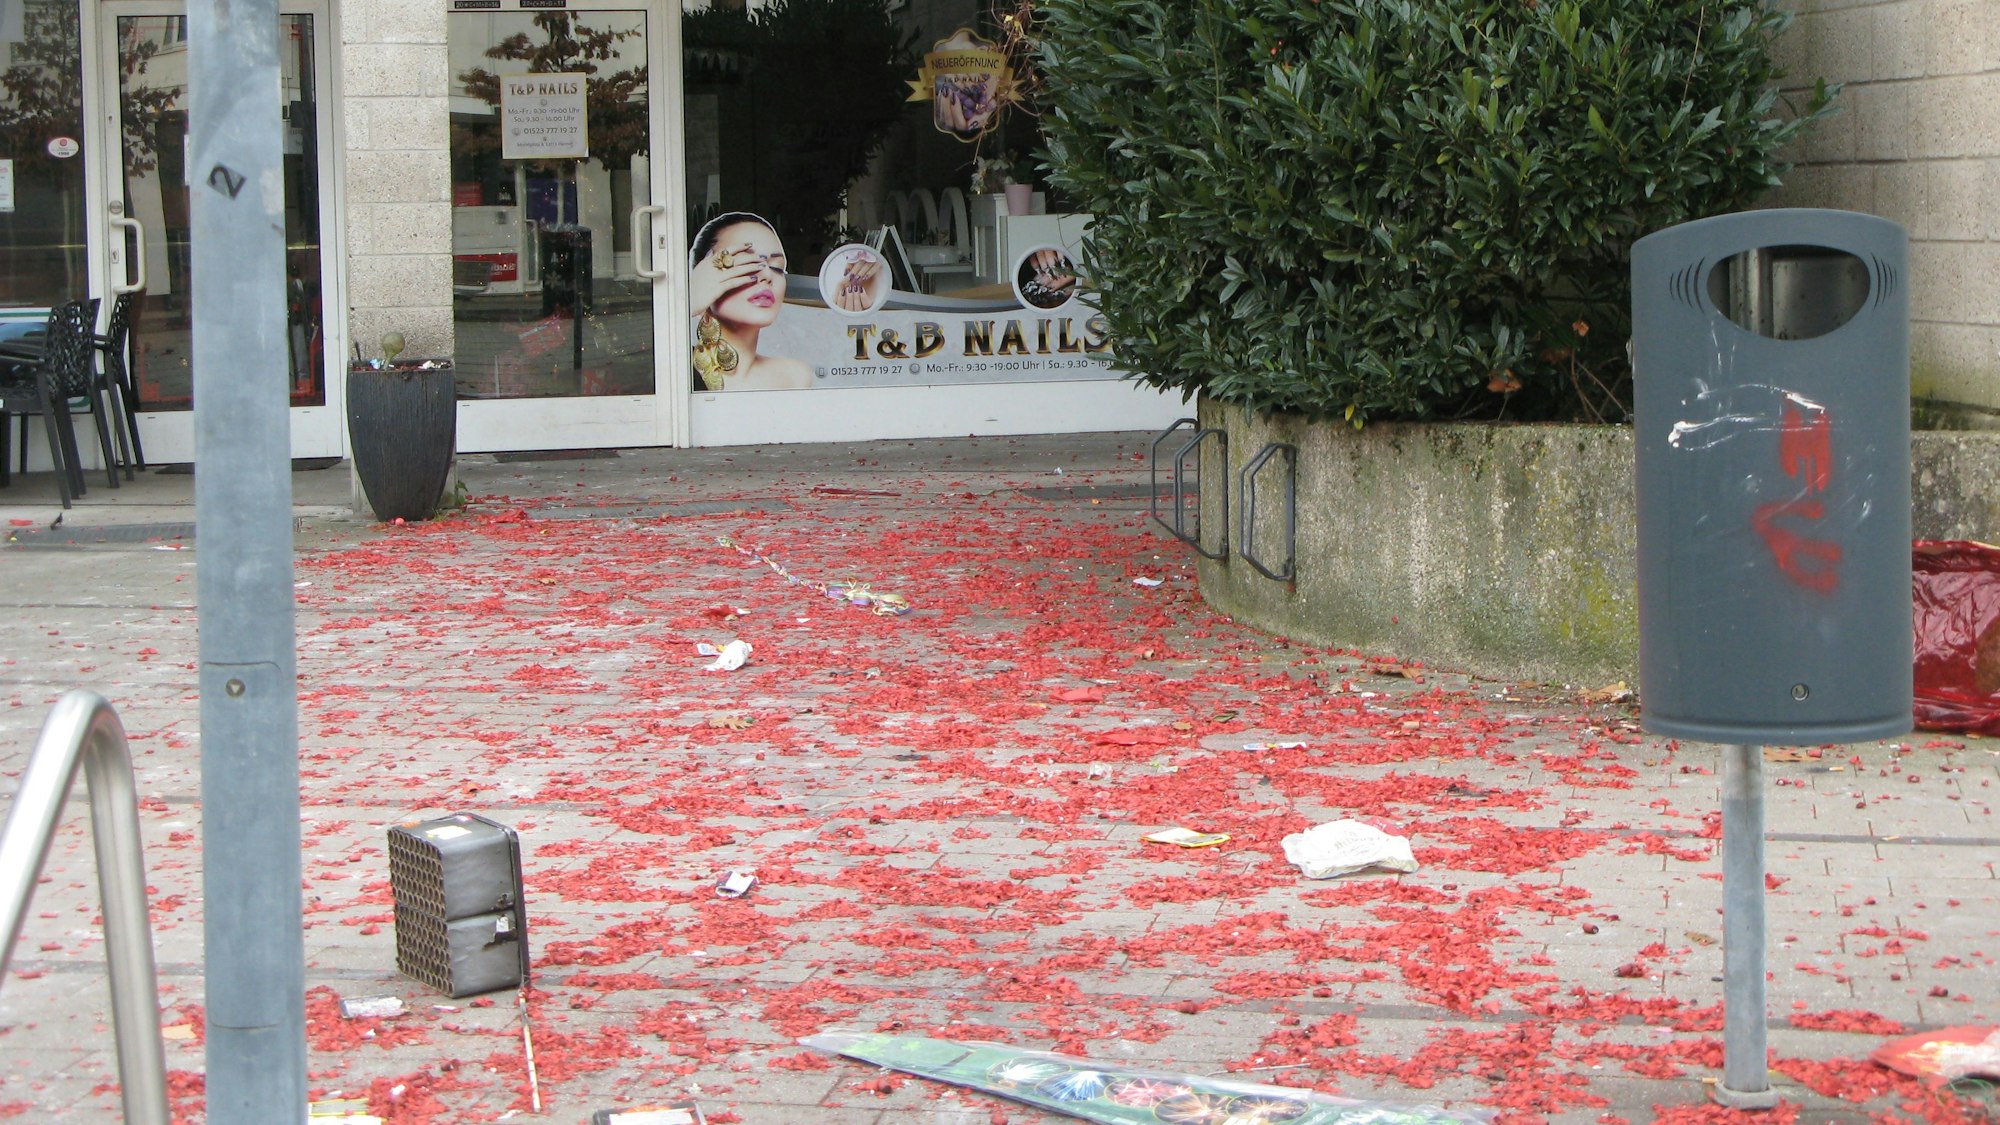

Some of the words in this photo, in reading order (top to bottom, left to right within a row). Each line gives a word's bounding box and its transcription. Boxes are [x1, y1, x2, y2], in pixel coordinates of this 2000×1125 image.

[931, 56, 1000, 69] NEUERÖFFNUNG
[539, 82, 578, 95] NAILS
[962, 313, 1115, 357] NAILS
[831, 367, 858, 376] 01523
[861, 366, 877, 375] 777
[879, 366, 889, 374] 19
[892, 365, 903, 374] 27
[926, 363, 964, 373] Mo.-Fr.:
[966, 363, 987, 371] 9:30
[1022, 361, 1040, 370] Uhr
[1067, 359, 1088, 368] 9.30
